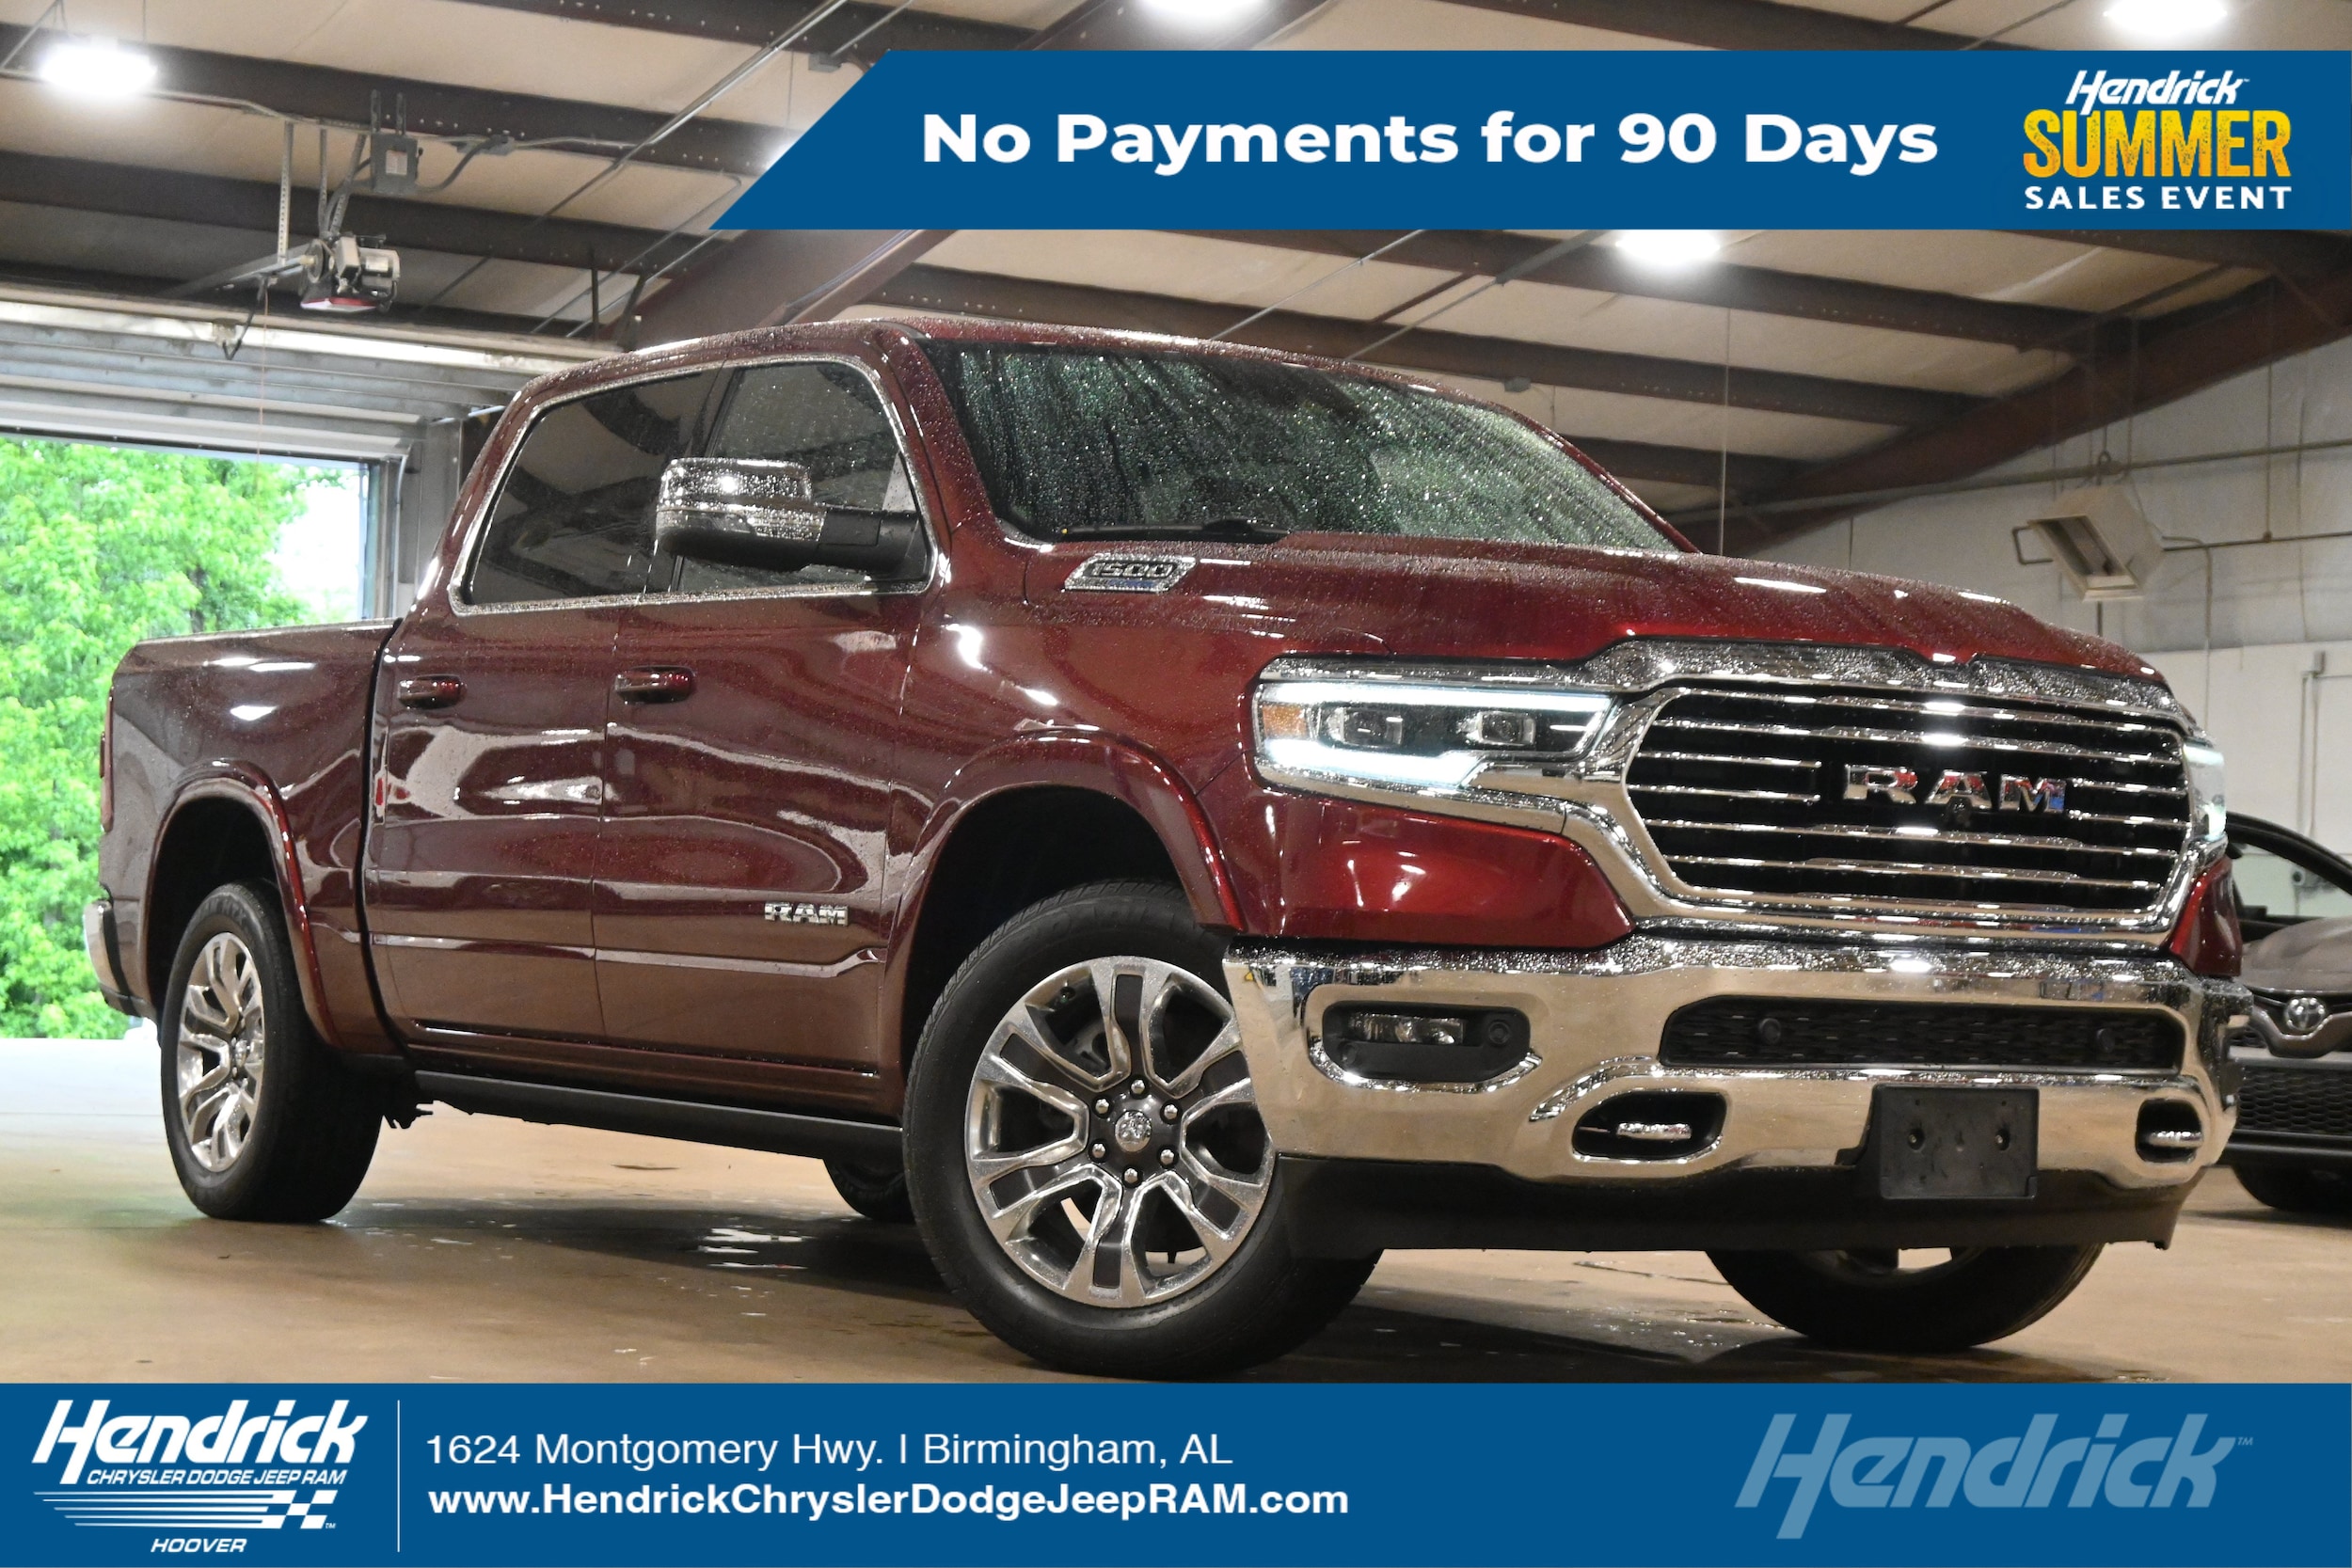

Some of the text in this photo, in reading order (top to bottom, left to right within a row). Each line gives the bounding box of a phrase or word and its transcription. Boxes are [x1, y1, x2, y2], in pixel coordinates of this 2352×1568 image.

[1089, 561, 1172, 578] 1500
[1844, 764, 2067, 813] RAM
[764, 901, 849, 927] RAM
